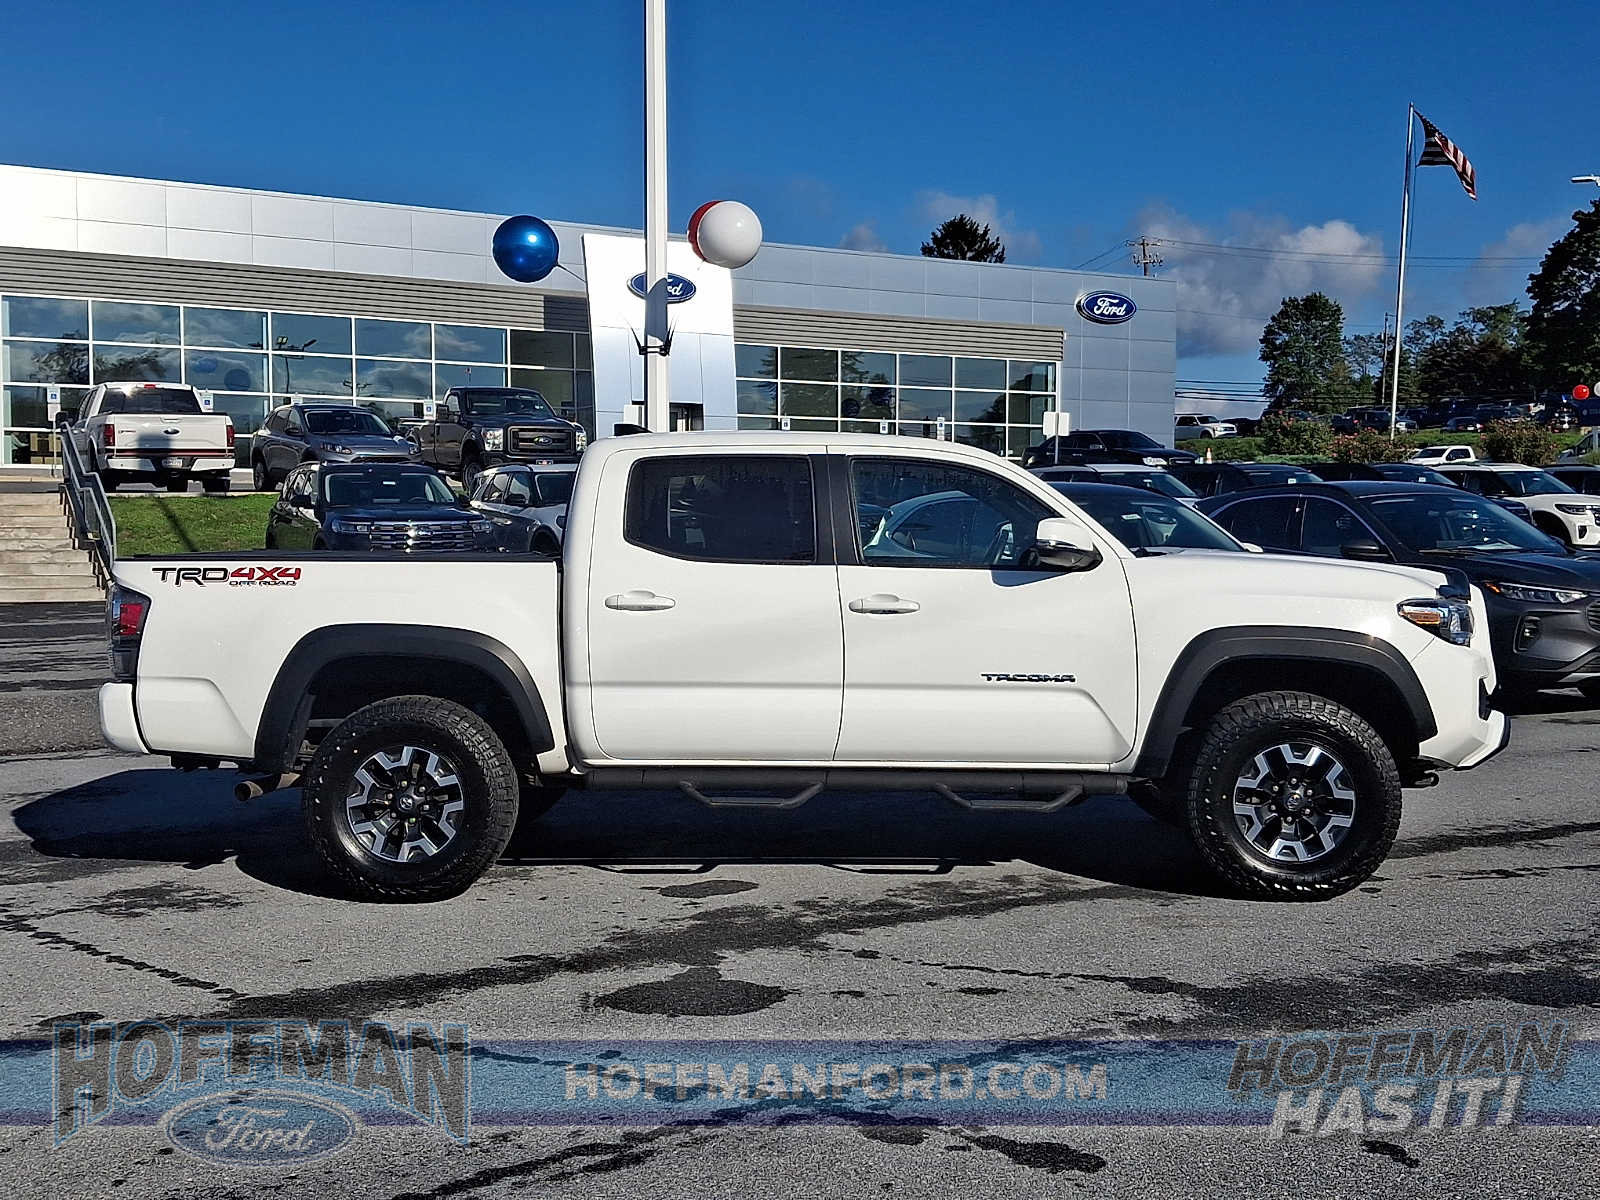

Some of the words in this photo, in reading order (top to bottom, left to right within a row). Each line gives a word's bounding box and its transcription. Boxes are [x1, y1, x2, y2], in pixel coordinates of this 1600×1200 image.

[1093, 297, 1127, 315] Ford
[152, 567, 229, 587] TRD
[980, 673, 1076, 683] TACOMA
